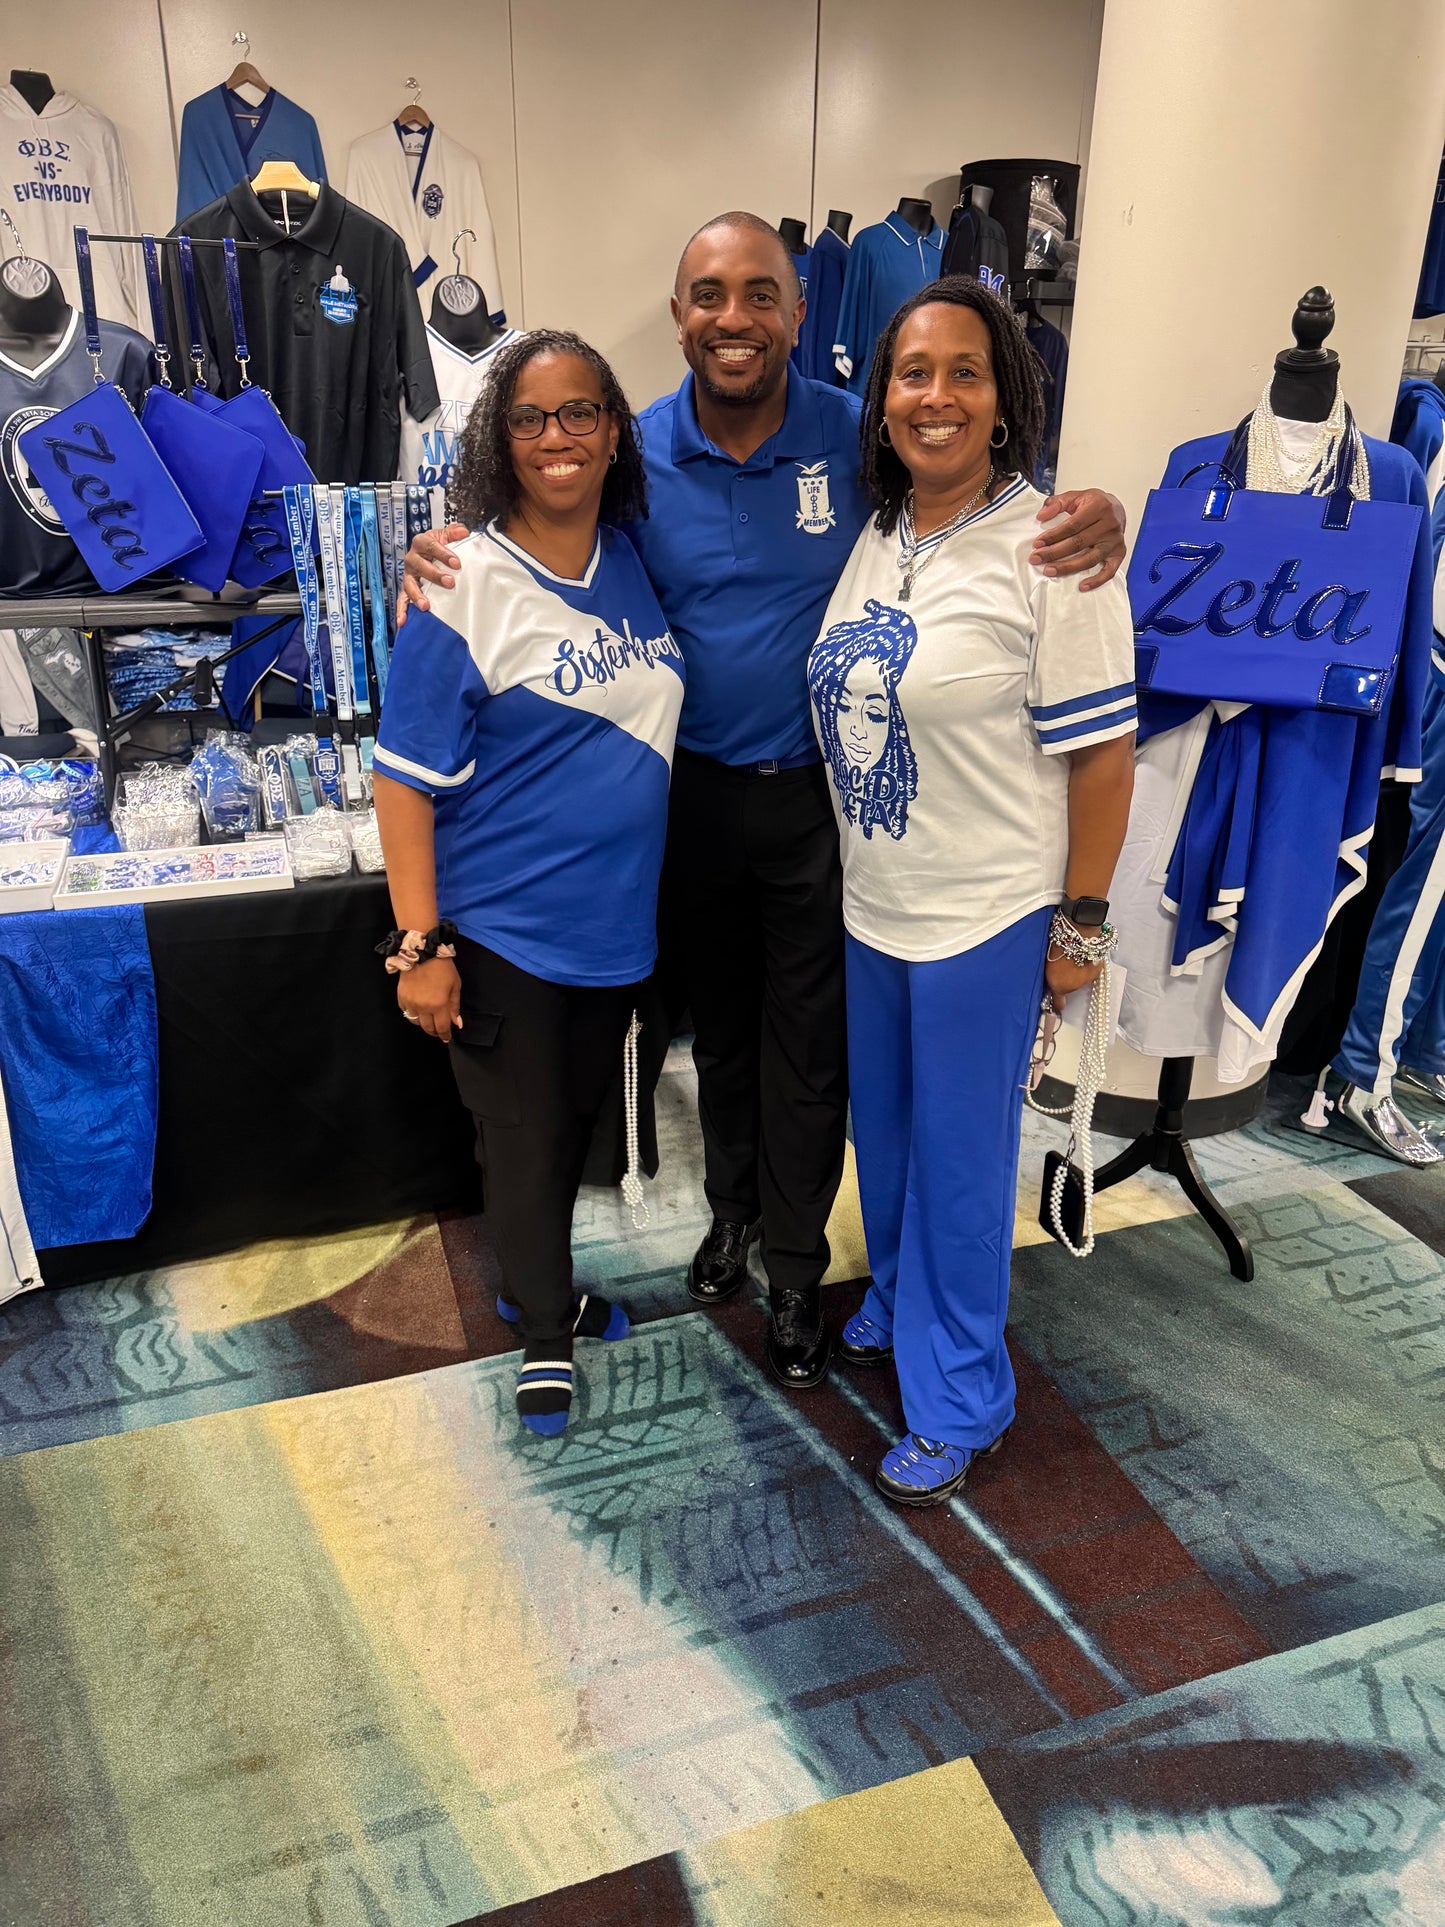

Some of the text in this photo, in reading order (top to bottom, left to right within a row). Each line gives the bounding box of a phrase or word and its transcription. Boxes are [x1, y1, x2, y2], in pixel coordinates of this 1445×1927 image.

[33, 161, 62, 180] -VS-
[13, 181, 91, 204] EVERYBODY
[5, 425, 17, 441] ZETA
[13, 415, 24, 427] PHI
[22, 410, 39, 419] BETA
[42, 421, 148, 570] Zeta
[807, 486, 821, 494] LIFE
[302, 497, 312, 519] Club
[289, 504, 302, 547] Member
[804, 517, 830, 527] MEMBER
[323, 535, 333, 557] Life
[383, 524, 391, 546] Zeta
[396, 530, 405, 551] Zeta
[295, 550, 306, 571] Life
[308, 574, 316, 594] SBC
[325, 560, 336, 601] Member
[1134, 541, 1372, 645] Zeta
[309, 600, 317, 621] Club
[334, 645, 343, 666] Life
[337, 668, 348, 707] Member
[842, 792, 893, 833] ETA
